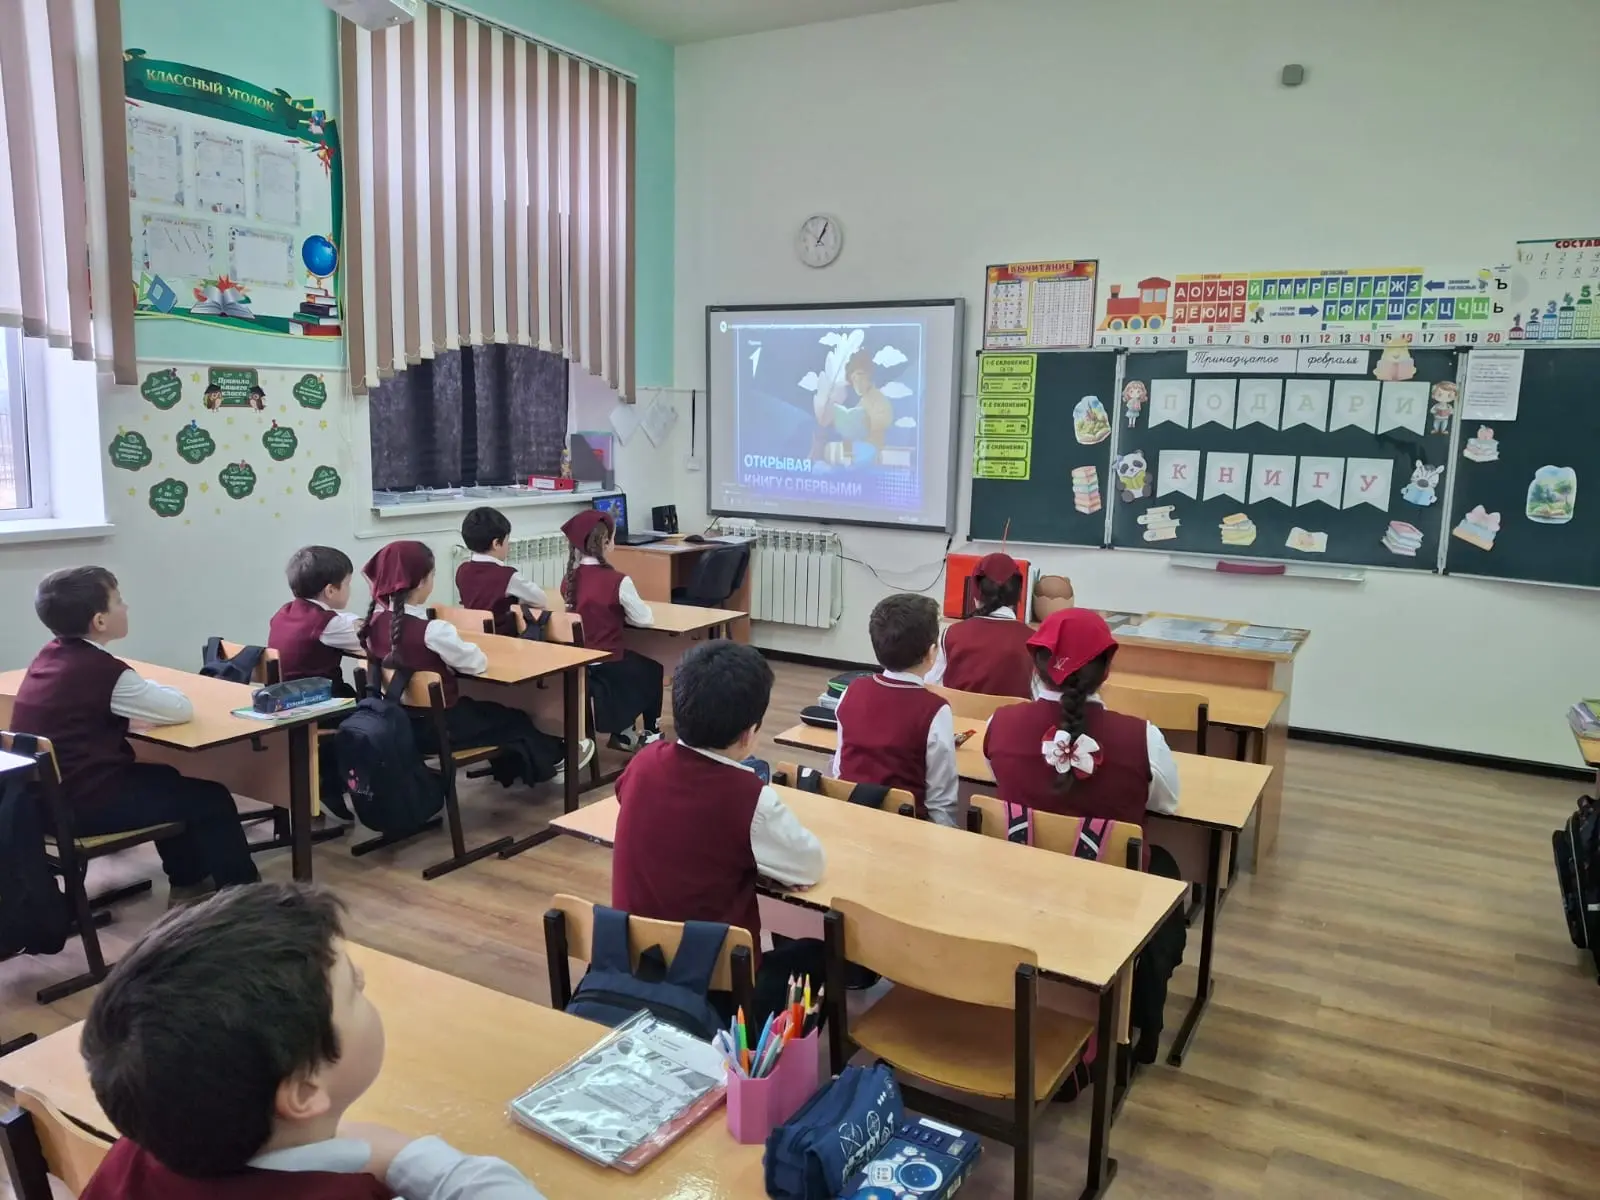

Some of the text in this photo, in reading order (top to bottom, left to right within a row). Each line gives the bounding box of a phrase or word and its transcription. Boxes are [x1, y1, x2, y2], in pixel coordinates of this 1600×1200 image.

[146, 68, 274, 112] КЛАССНЫЙ УГОЛОК
[1011, 263, 1071, 272] ВЫЧИТАНИЕ
[1495, 278, 1508, 290] Ъ
[1530, 308, 1539, 320] 2
[1547, 300, 1557, 313] 3
[1581, 285, 1591, 297] 5
[1153, 336, 1158, 344] 3
[1170, 336, 1176, 344] 4
[1189, 335, 1194, 344] 5
[1226, 335, 1232, 343] 7
[1263, 334, 1269, 343] 9
[1280, 334, 1291, 343] 10
[1300, 334, 1310, 343] 11
[1320, 334, 1330, 343] 12
[1340, 334, 1351, 343] 13
[1360, 334, 1370, 342] 14
[1423, 333, 1434, 343] 17
[1444, 333, 1456, 342] 18
[1466, 333, 1477, 342] 19
[1487, 333, 1500, 342] 20
[1192, 352, 1358, 368] Тринадцатое февраля
[744, 454, 812, 472] ОТКРЫВАЯ
[744, 473, 862, 496] КНИГУ С ПЕРВЫМИ
